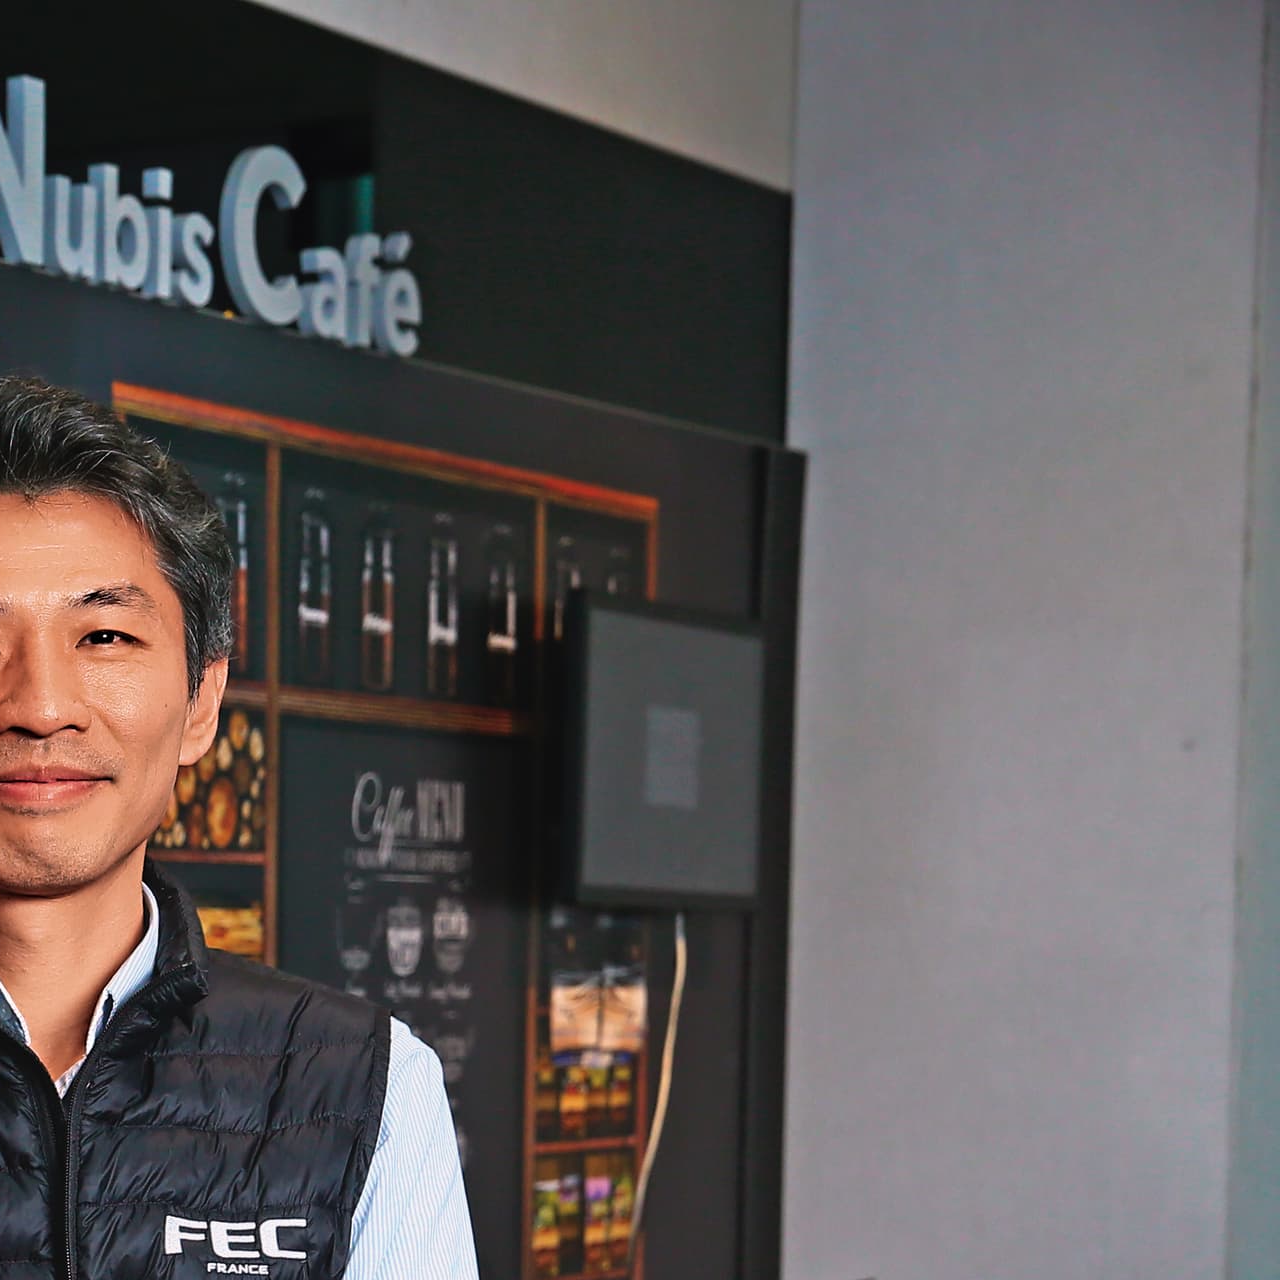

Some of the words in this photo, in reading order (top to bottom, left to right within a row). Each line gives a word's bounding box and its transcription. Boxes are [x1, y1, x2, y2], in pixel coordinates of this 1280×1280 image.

[220, 144, 422, 358] Café
[164, 1215, 307, 1259] FEC
[207, 1262, 269, 1275] FRANCE
